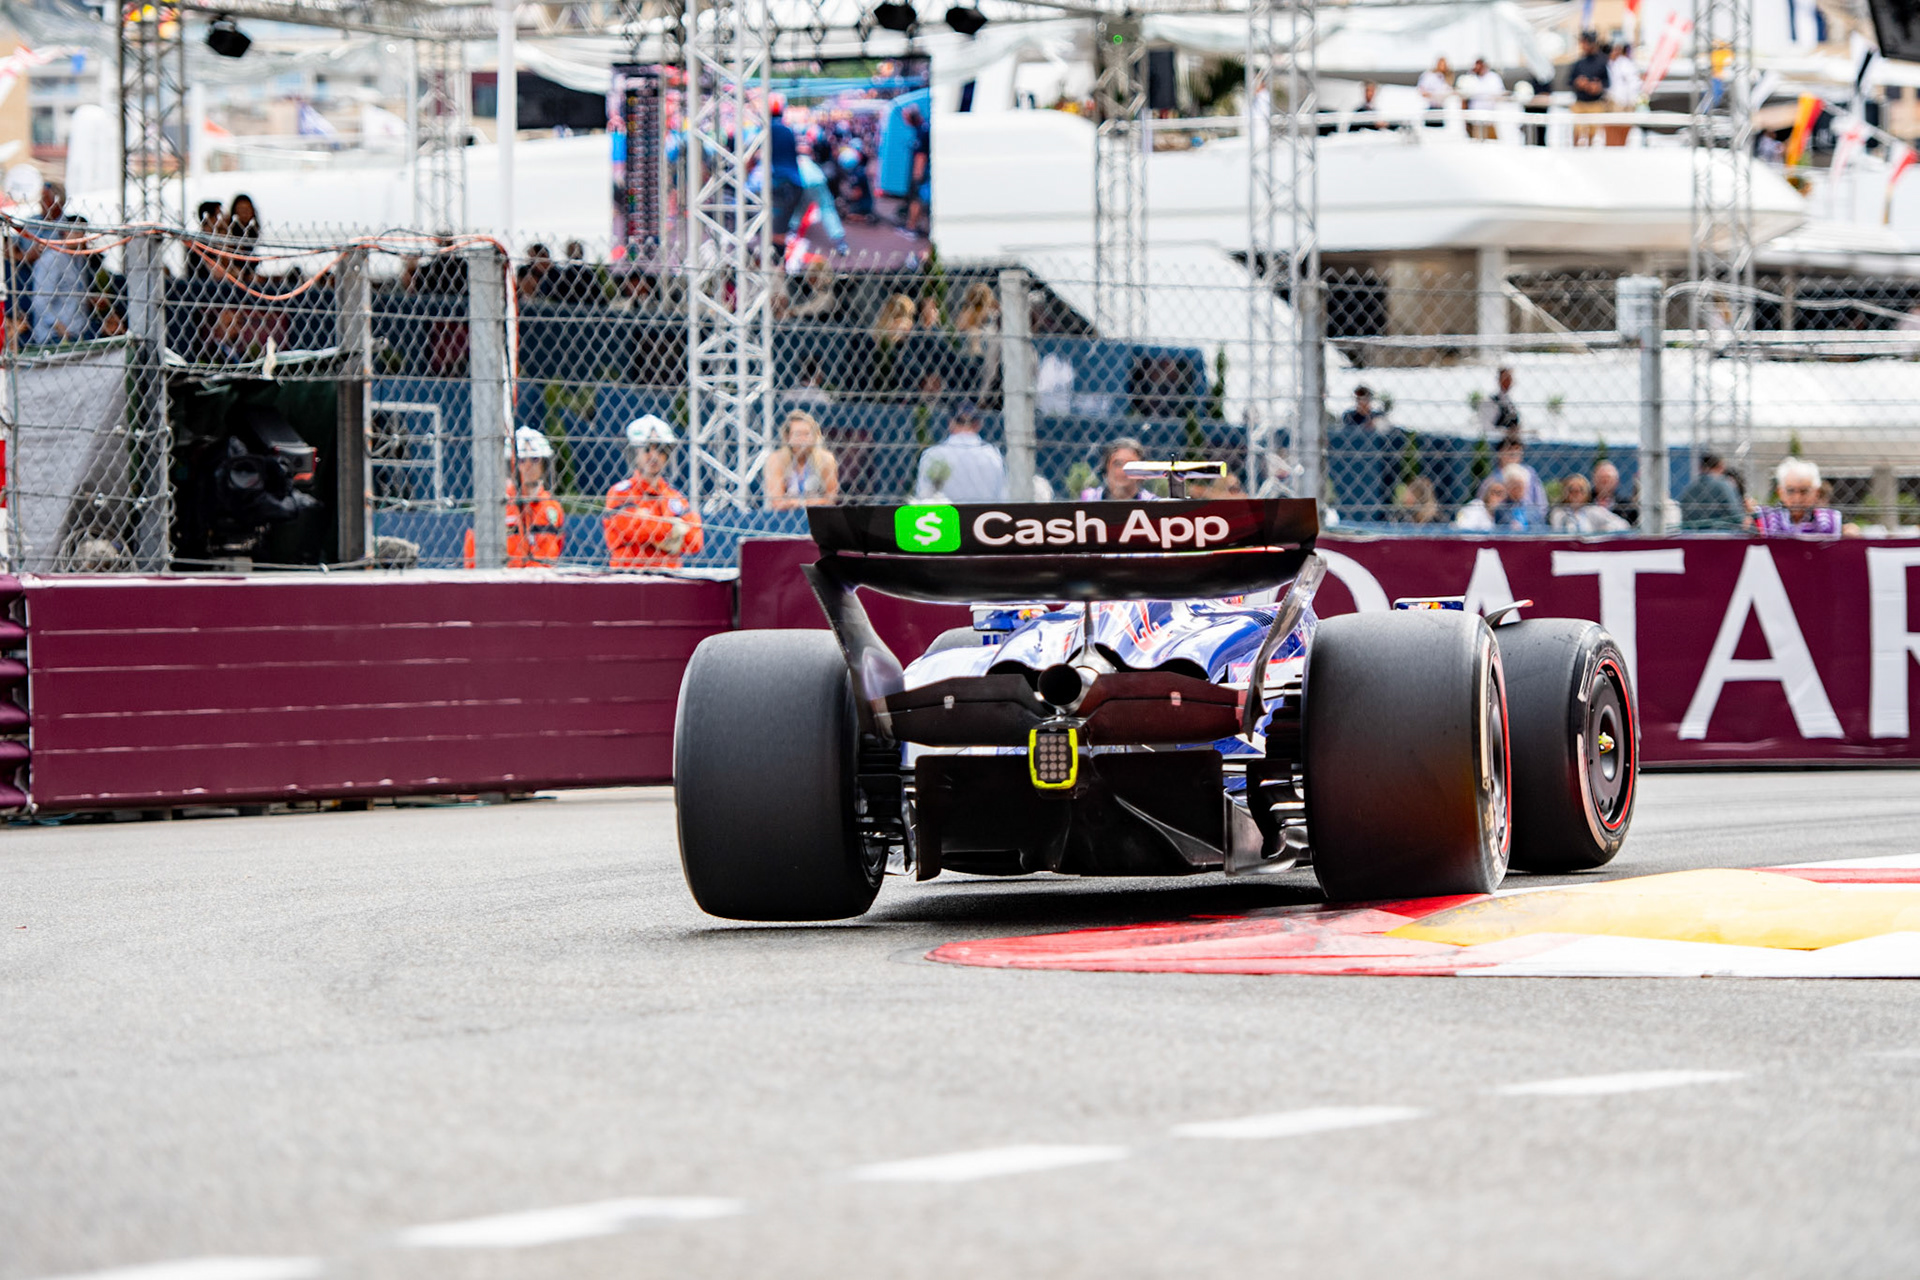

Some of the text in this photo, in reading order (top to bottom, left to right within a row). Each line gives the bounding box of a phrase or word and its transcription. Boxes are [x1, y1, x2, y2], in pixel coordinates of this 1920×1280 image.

[972, 510, 1107, 546] Cash
[1118, 508, 1230, 549] App
[1312, 545, 1920, 741] ATA
